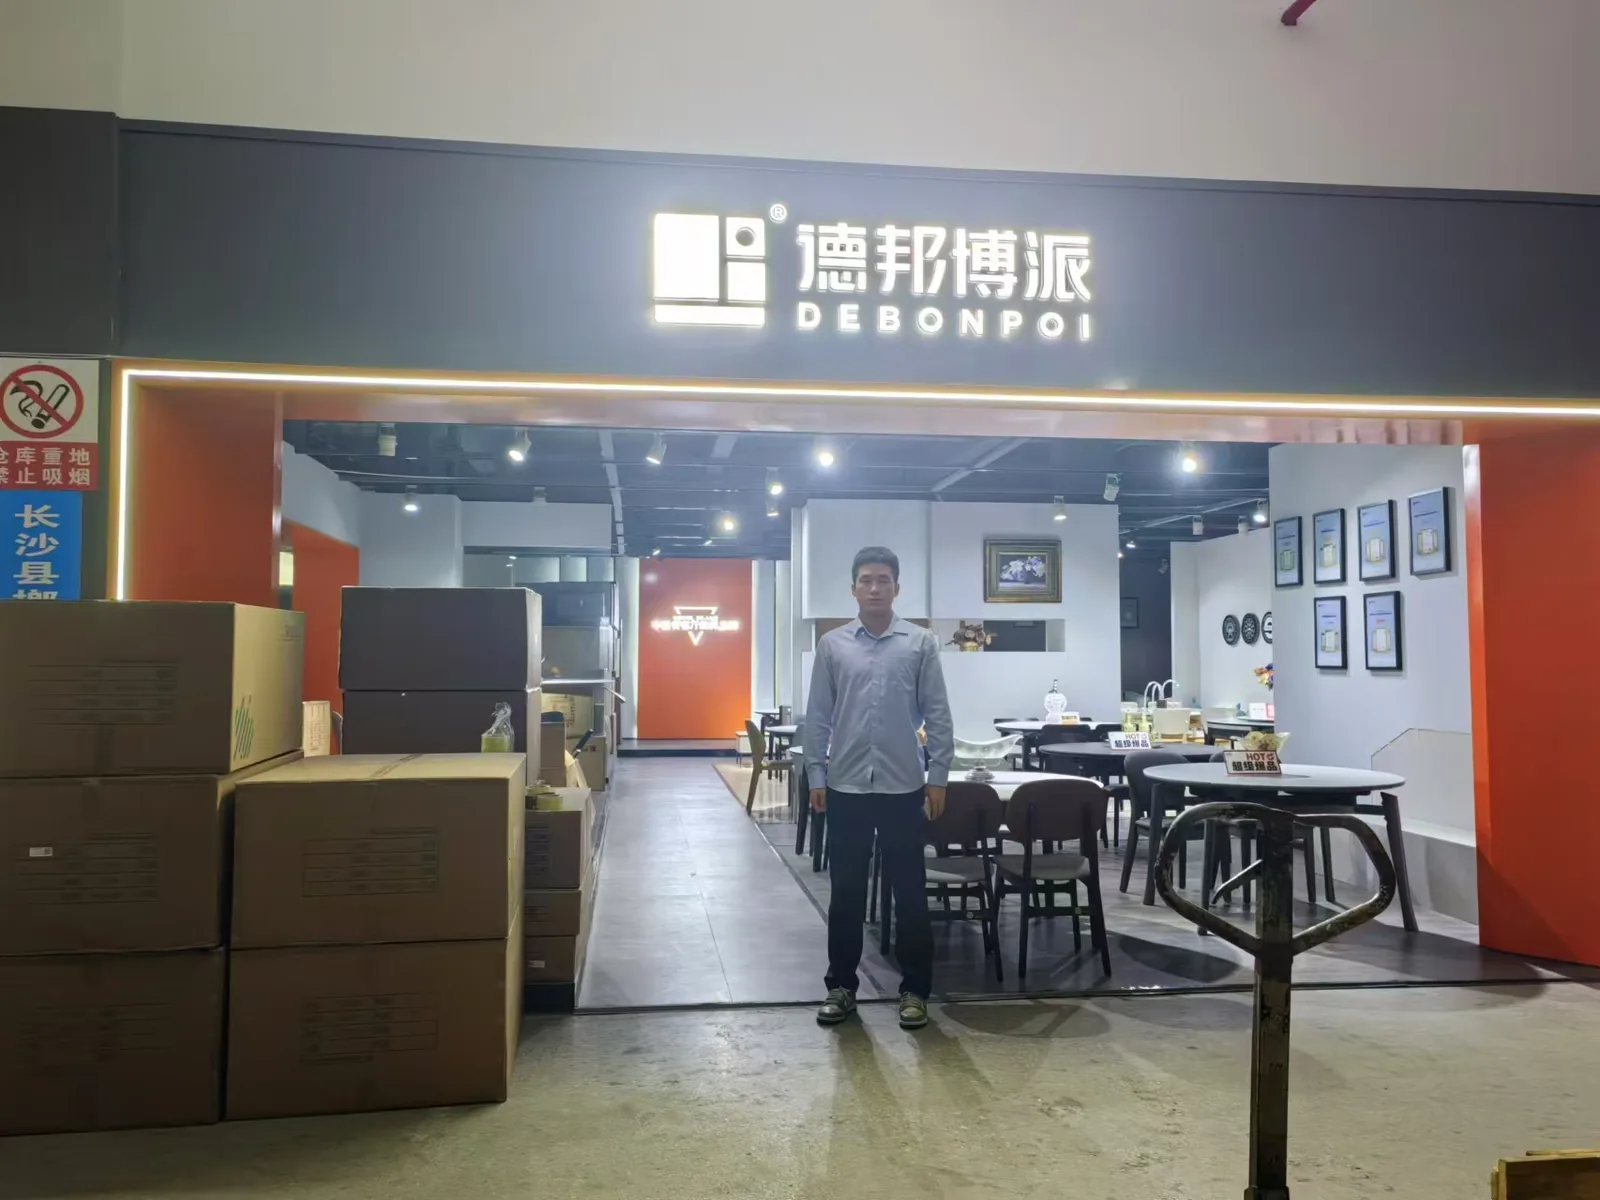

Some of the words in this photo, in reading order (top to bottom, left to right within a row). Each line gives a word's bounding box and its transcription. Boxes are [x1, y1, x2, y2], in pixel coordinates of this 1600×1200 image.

[796, 222, 1091, 302] 德邦博派
[797, 302, 1090, 340] DEBONPOI
[1246, 753, 1266, 761] HOT
